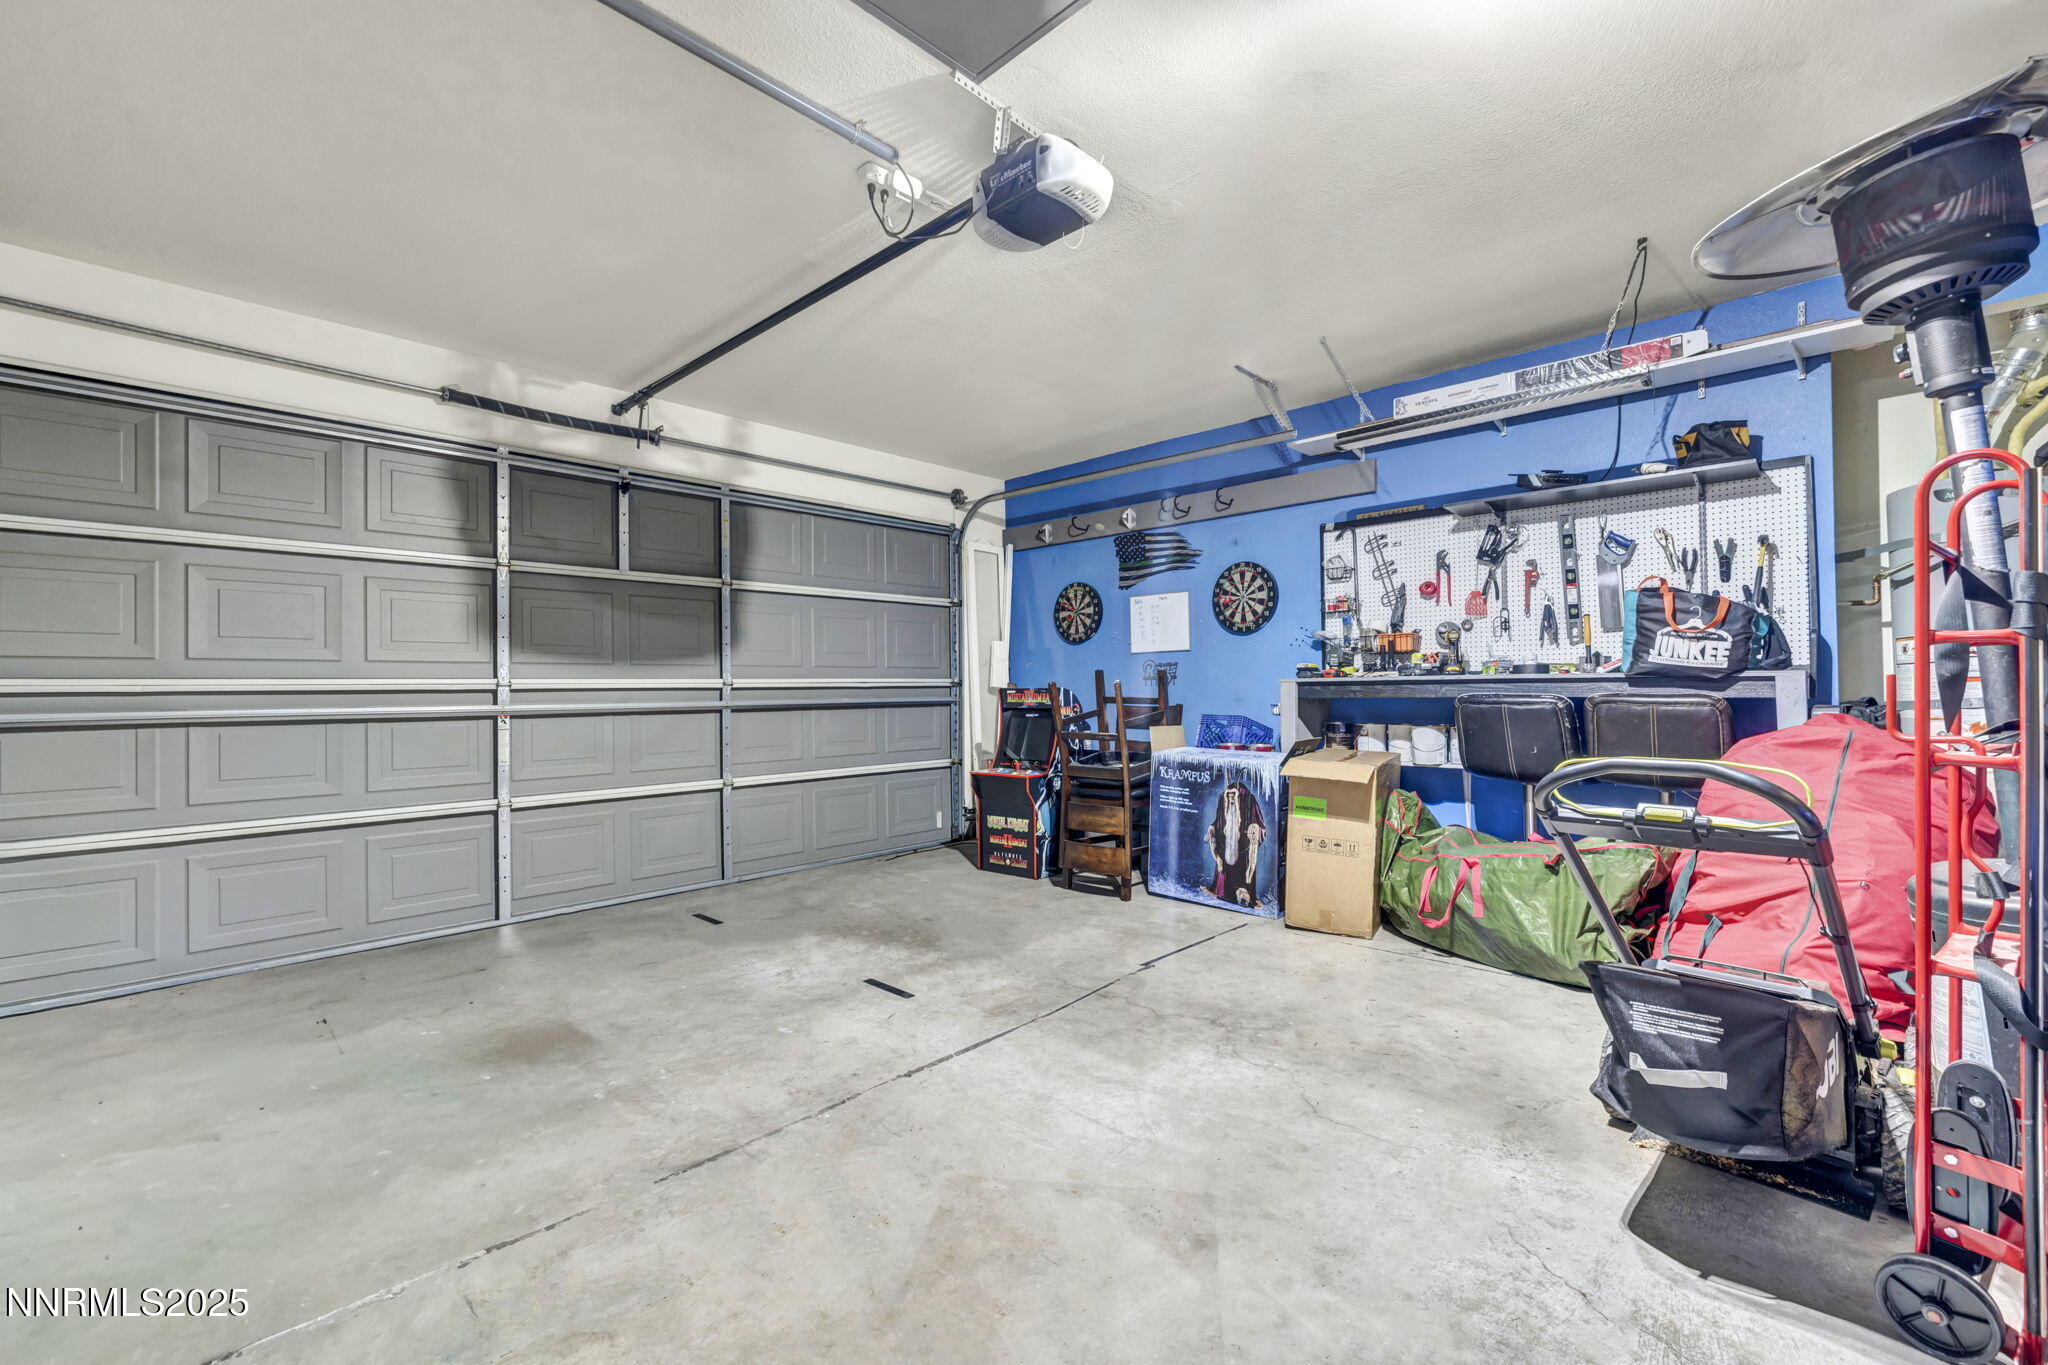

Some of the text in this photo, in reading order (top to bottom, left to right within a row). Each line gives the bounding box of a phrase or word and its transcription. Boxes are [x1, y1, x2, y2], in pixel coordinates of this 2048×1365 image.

[990, 159, 1033, 188] LMaster
[1649, 635, 1733, 662] JUNKEE
[1652, 656, 1725, 667] CLOTHING EXCHANGE
[1160, 765, 1211, 783] KRAMPUS
